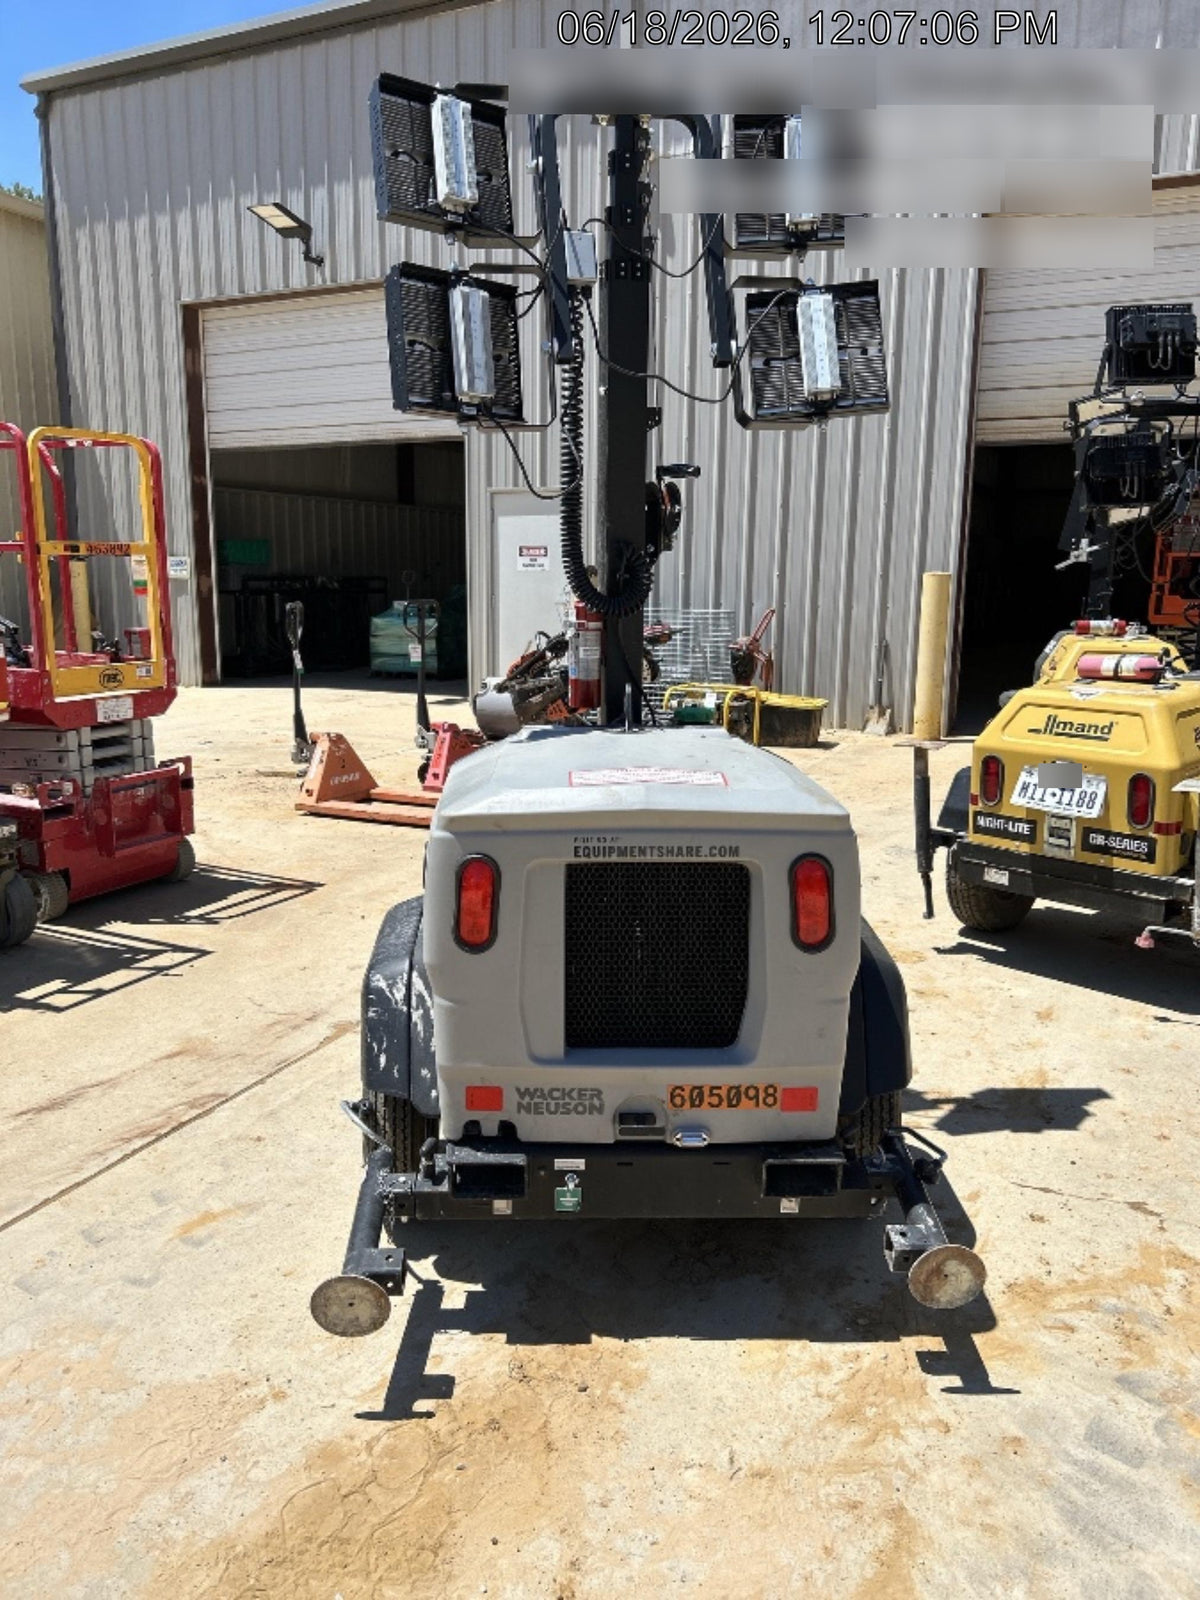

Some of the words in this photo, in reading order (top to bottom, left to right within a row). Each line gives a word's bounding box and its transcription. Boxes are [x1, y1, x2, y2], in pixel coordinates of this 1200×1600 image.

[573, 845, 740, 859] EQUIPMENTSHARE.COM
[515, 1086, 604, 1101] WACKER
[669, 1084, 779, 1109] 605098
[516, 1102, 605, 1116] NEUSON
